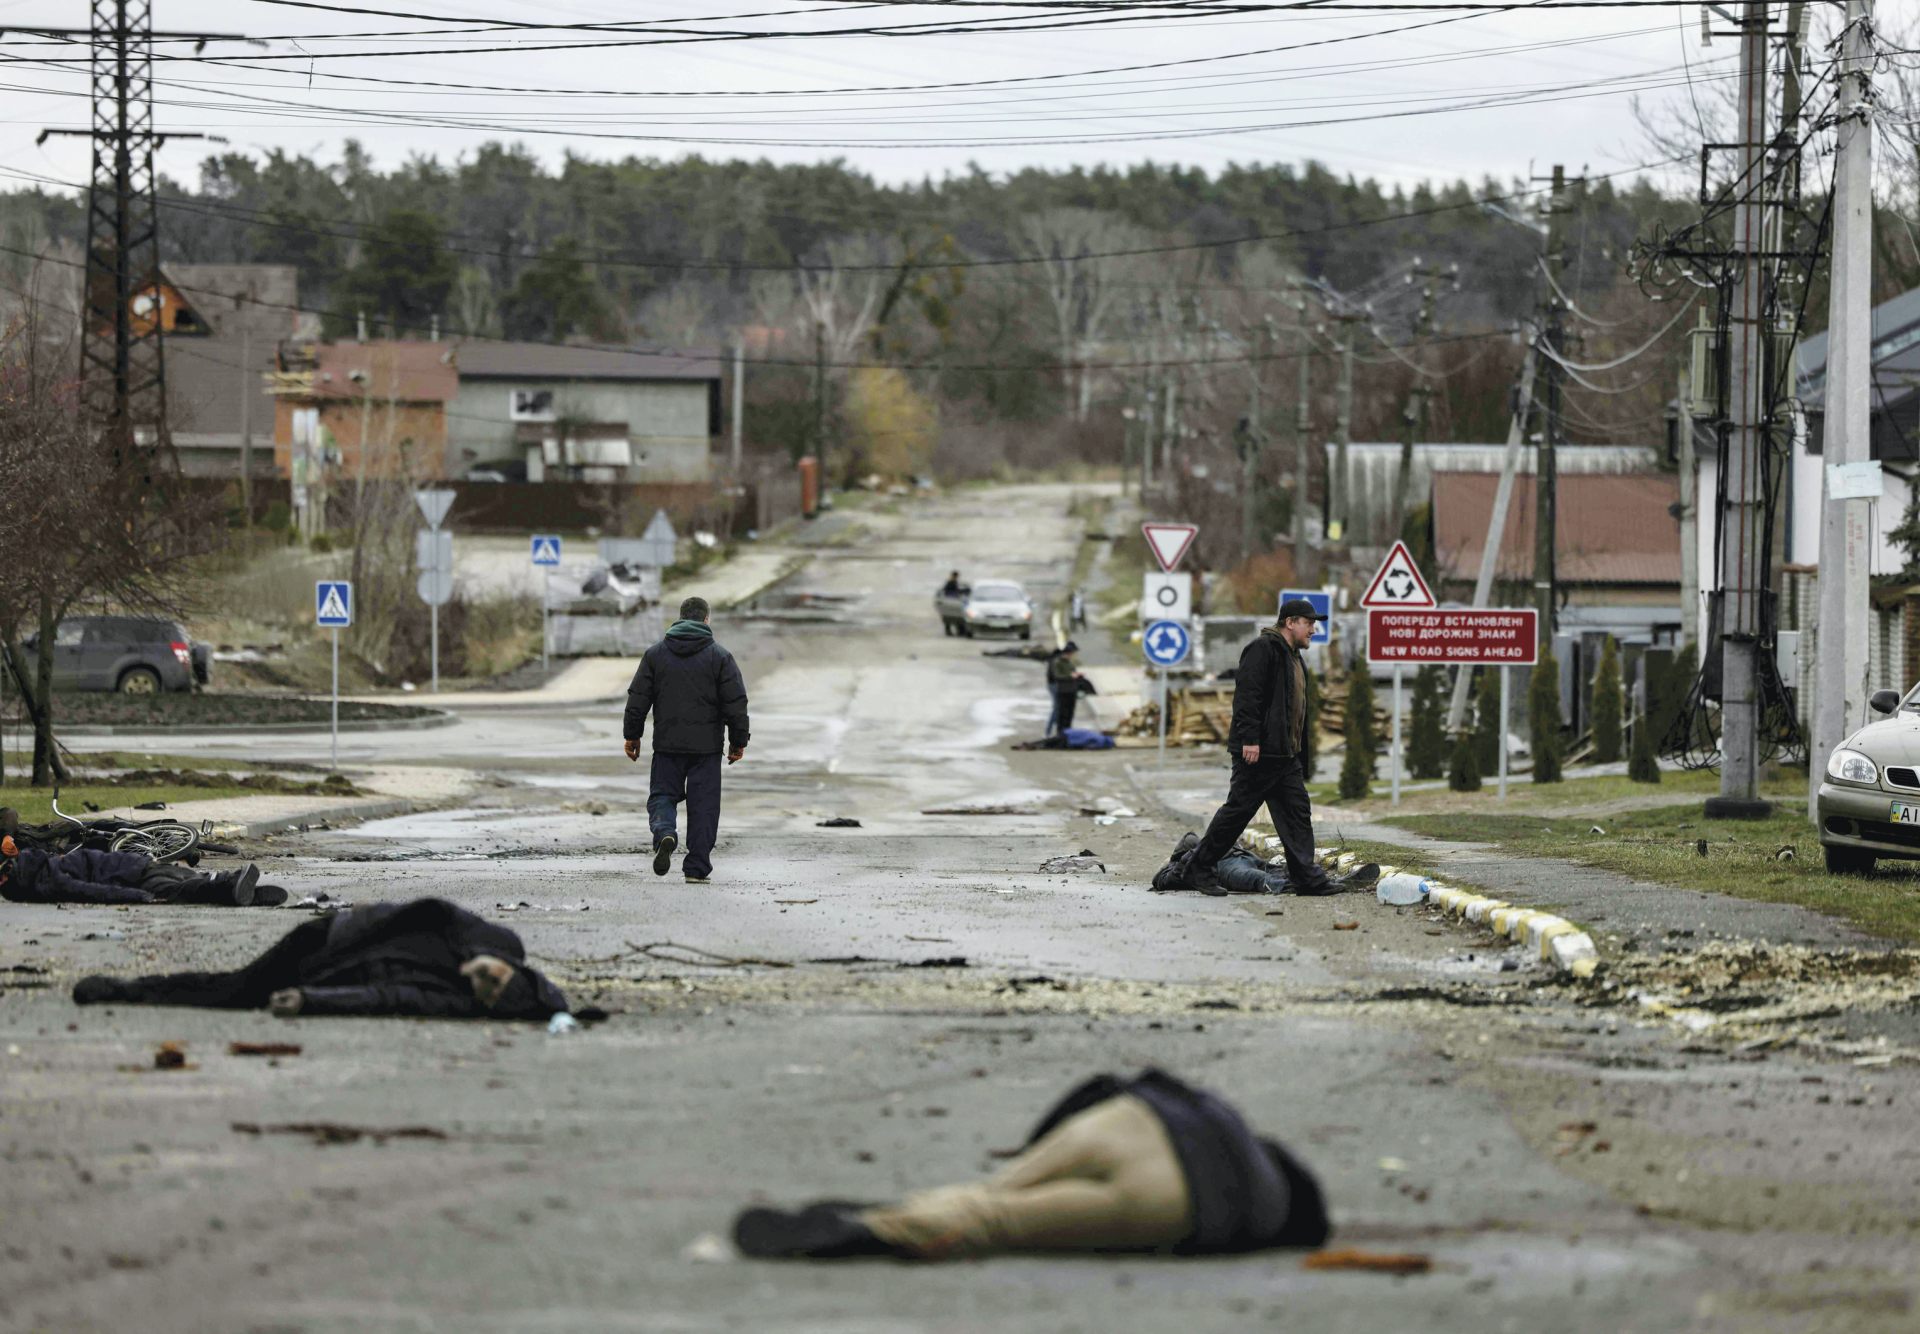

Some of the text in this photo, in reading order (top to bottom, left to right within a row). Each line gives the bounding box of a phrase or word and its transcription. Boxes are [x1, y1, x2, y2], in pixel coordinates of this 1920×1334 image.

[1382, 616, 1523, 627] ПОПЕРЕДУ ВСТАНОВЛЕНІ
[1389, 629, 1516, 640] НОВІ ДОРОЖНІ ЗНАКИ
[1382, 646, 1523, 657] NEW ROAD SIGNS AHEAD
